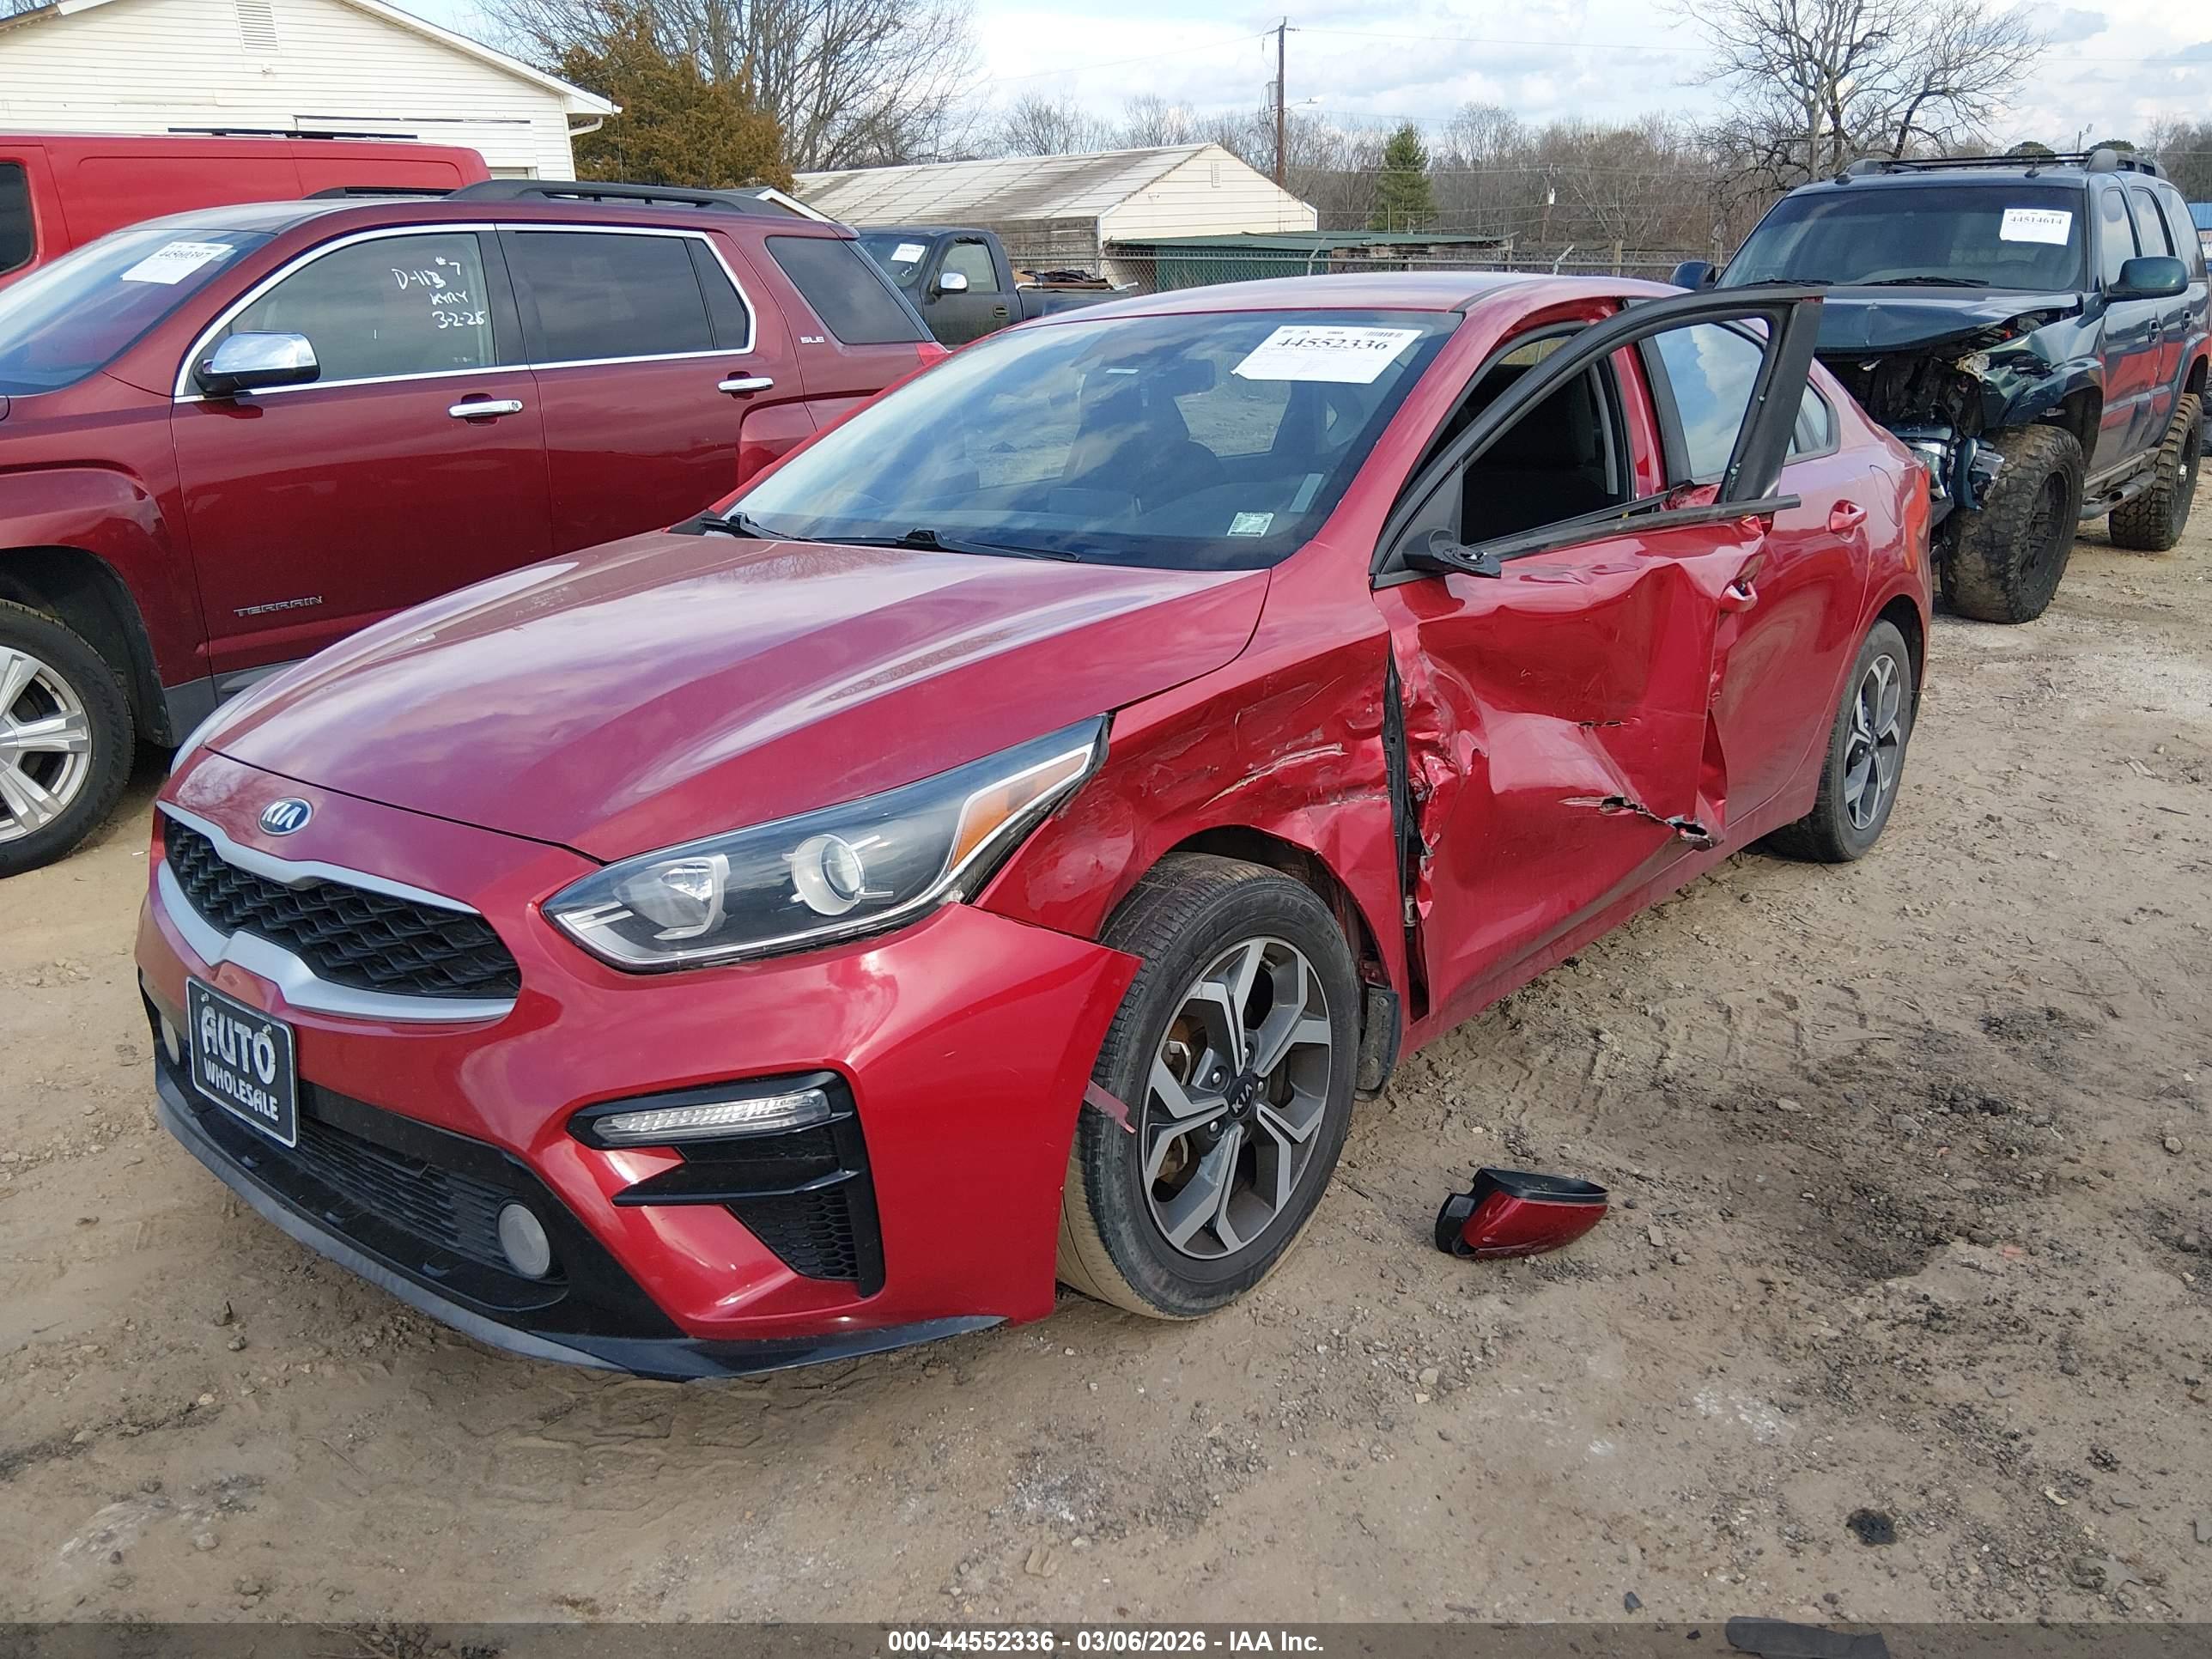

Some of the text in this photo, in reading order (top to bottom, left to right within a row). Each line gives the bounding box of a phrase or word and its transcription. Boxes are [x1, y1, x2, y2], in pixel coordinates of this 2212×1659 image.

[2010, 216, 2062, 225] 44514614
[1276, 337, 1389, 351] 44552336
[233, 595, 323, 617] TERRAIN
[261, 801, 302, 830] KIA
[201, 1006, 276, 1085] AUTO
[204, 1057, 279, 1121] WHOLESALE
[1231, 1083, 1253, 1114] KIA
